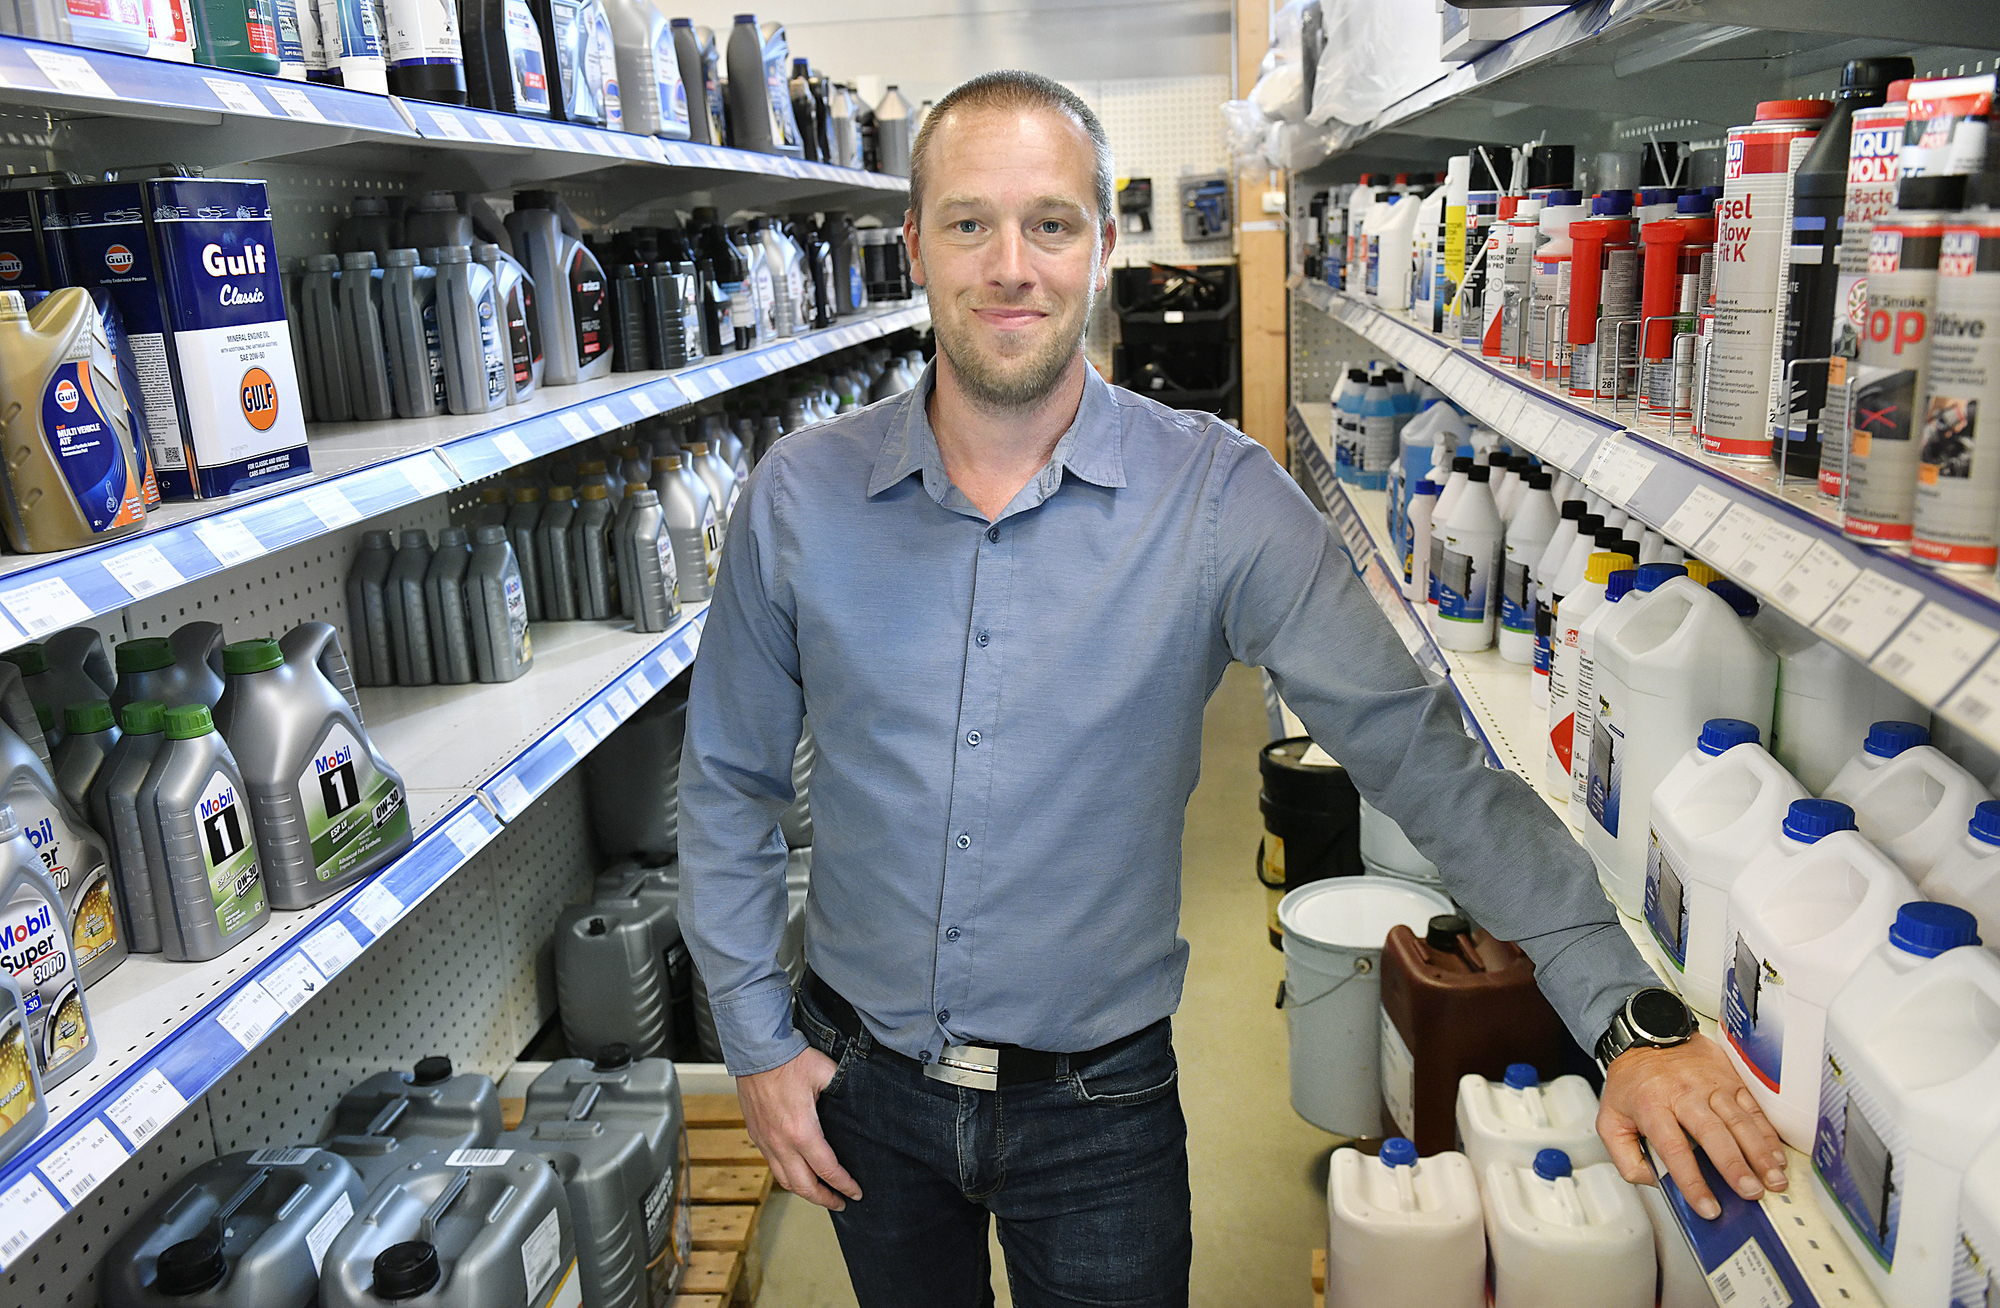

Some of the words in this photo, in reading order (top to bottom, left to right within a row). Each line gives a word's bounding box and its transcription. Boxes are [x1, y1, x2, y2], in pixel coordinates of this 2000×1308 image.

[1724, 193, 1753, 220] sel
[106, 254, 132, 264] Gulf
[202, 244, 267, 278] Gulf
[1734, 242, 1747, 262] K
[219, 284, 265, 306] Classic
[226, 334, 248, 343] MINERAL
[248, 331, 262, 340] ENGINE
[1870, 310, 1926, 354] op
[240, 354, 248, 362] SAE
[57, 391, 78, 403] Gulf
[243, 382, 274, 414] GULF
[56, 427, 78, 438] MULTI
[77, 422, 101, 435] VEHICLE
[60, 436, 72, 446] ATF
[248, 470, 259, 478] CARS
[254, 459, 268, 468] CLASSIC
[315, 745, 352, 774] Mobil
[330, 769, 350, 810] 1
[200, 786, 234, 820] Mobil
[376, 789, 399, 819] 0W-30
[214, 813, 234, 858] 1
[330, 825, 340, 838] ESP
[338, 850, 358, 865] Advanced
[236, 864, 256, 890] 0W-30
[0, 904, 52, 954] Mobil
[1, 933, 56, 976] Super
[33, 952, 66, 986] 3000
